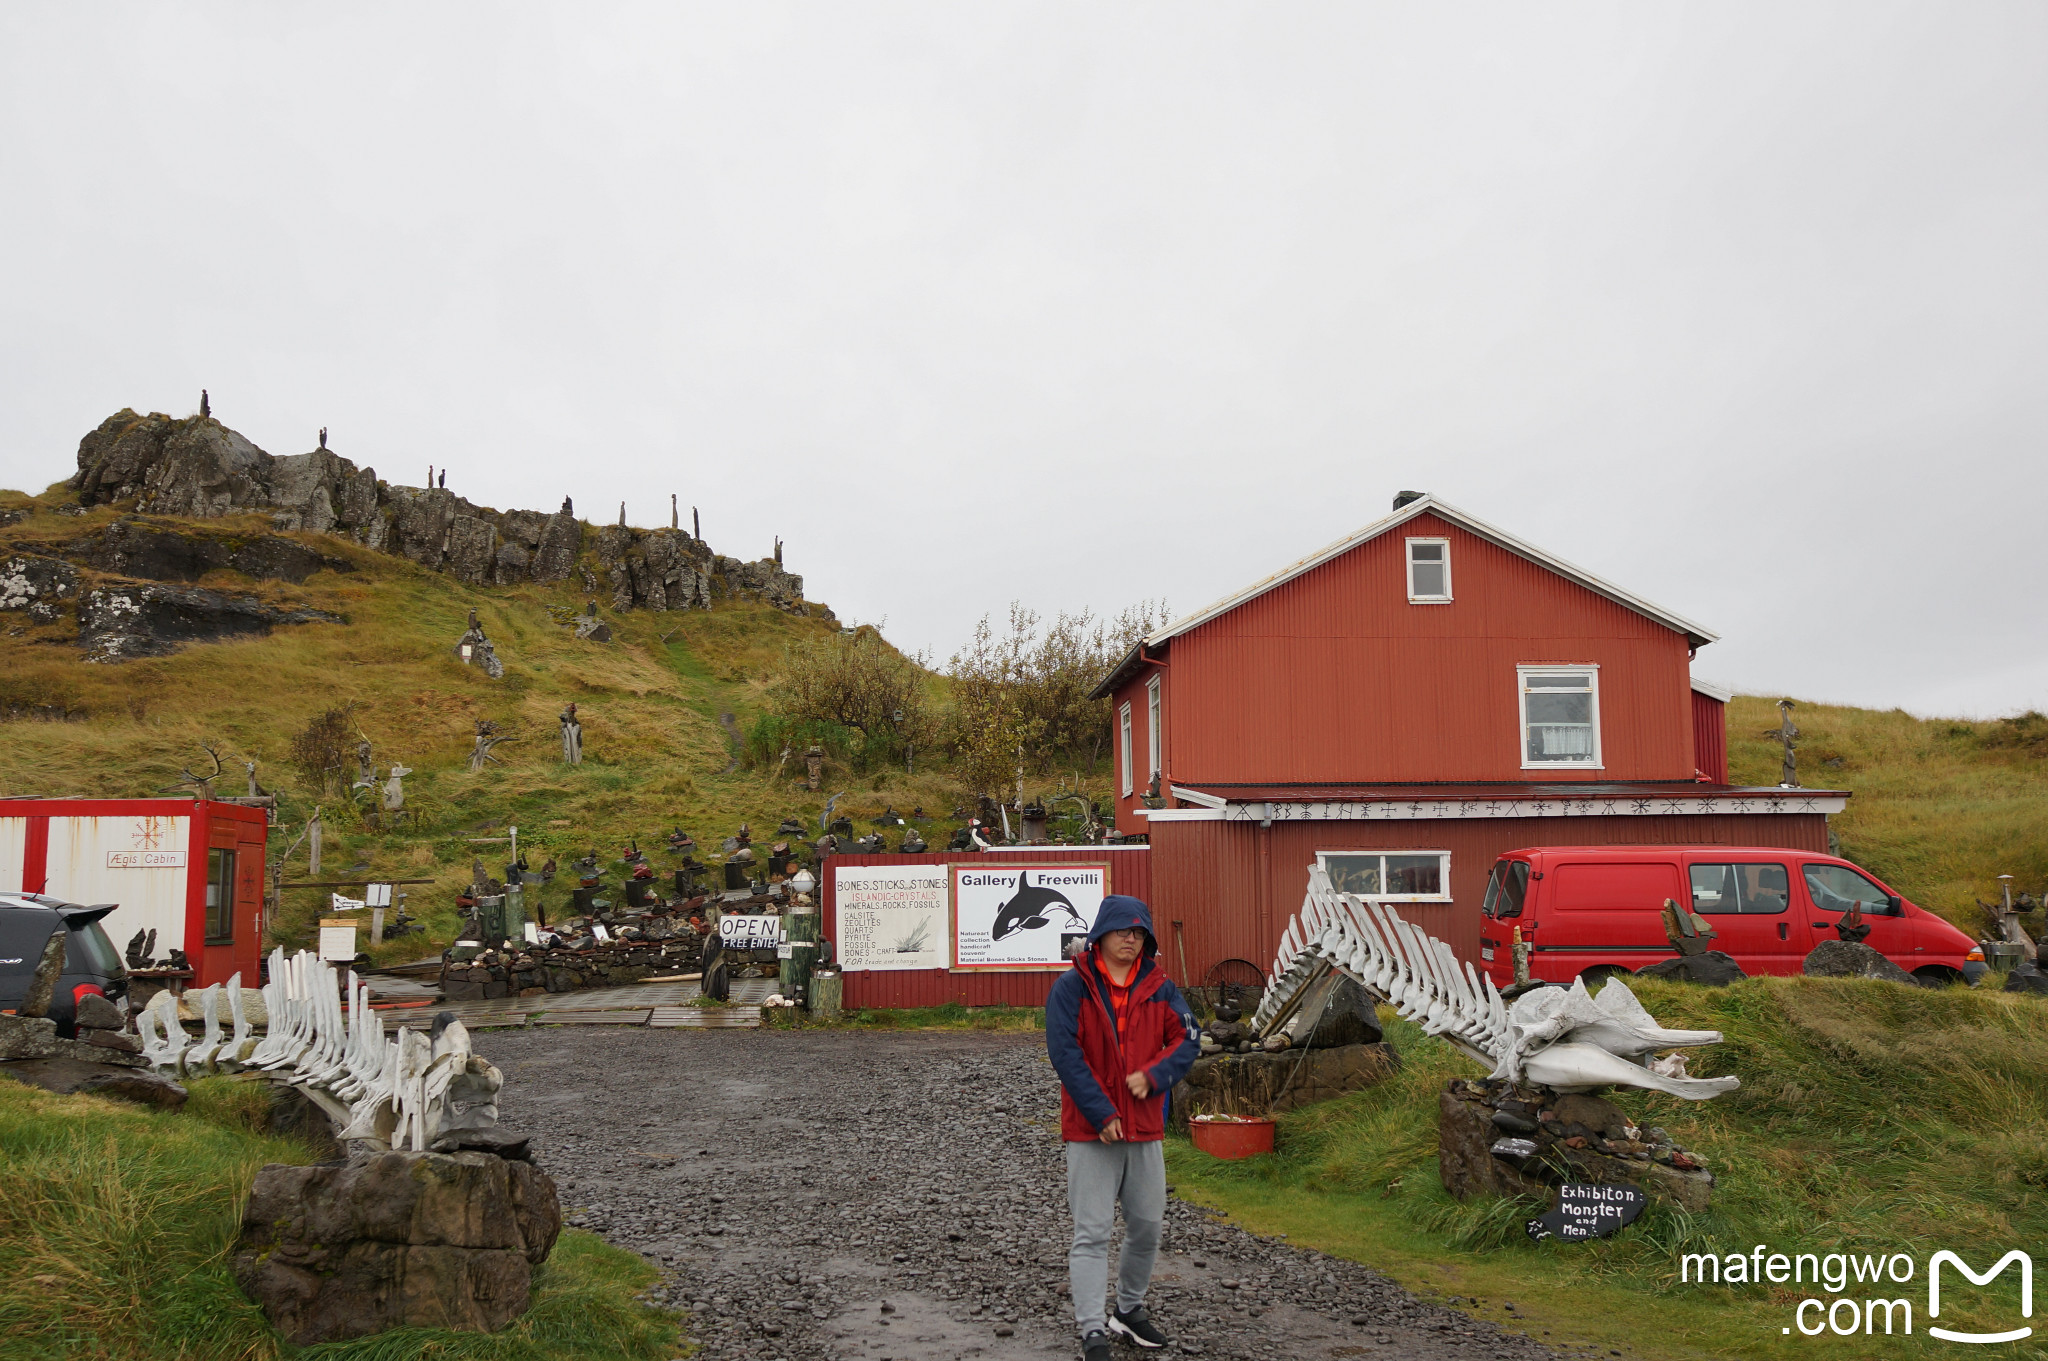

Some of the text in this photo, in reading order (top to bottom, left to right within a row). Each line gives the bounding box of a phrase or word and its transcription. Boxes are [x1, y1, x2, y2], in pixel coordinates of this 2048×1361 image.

[110, 853, 176, 867] Ægis Cabin
[911, 879, 948, 889] STONES
[961, 873, 1098, 889] Gallery Freevilli
[844, 911, 875, 920] CALSITE
[844, 918, 881, 927] ZEOLITES
[721, 919, 776, 936] OPEN
[844, 926, 874, 934] QUARTS
[844, 933, 871, 941] PYRITE
[722, 938, 779, 948] FREE ENTER
[844, 941, 876, 949] FOSSILS
[844, 949, 870, 957] BONES
[844, 957, 863, 966] FOR
[1561, 1201, 1624, 1218] Monster
[1575, 1216, 1598, 1225] and
